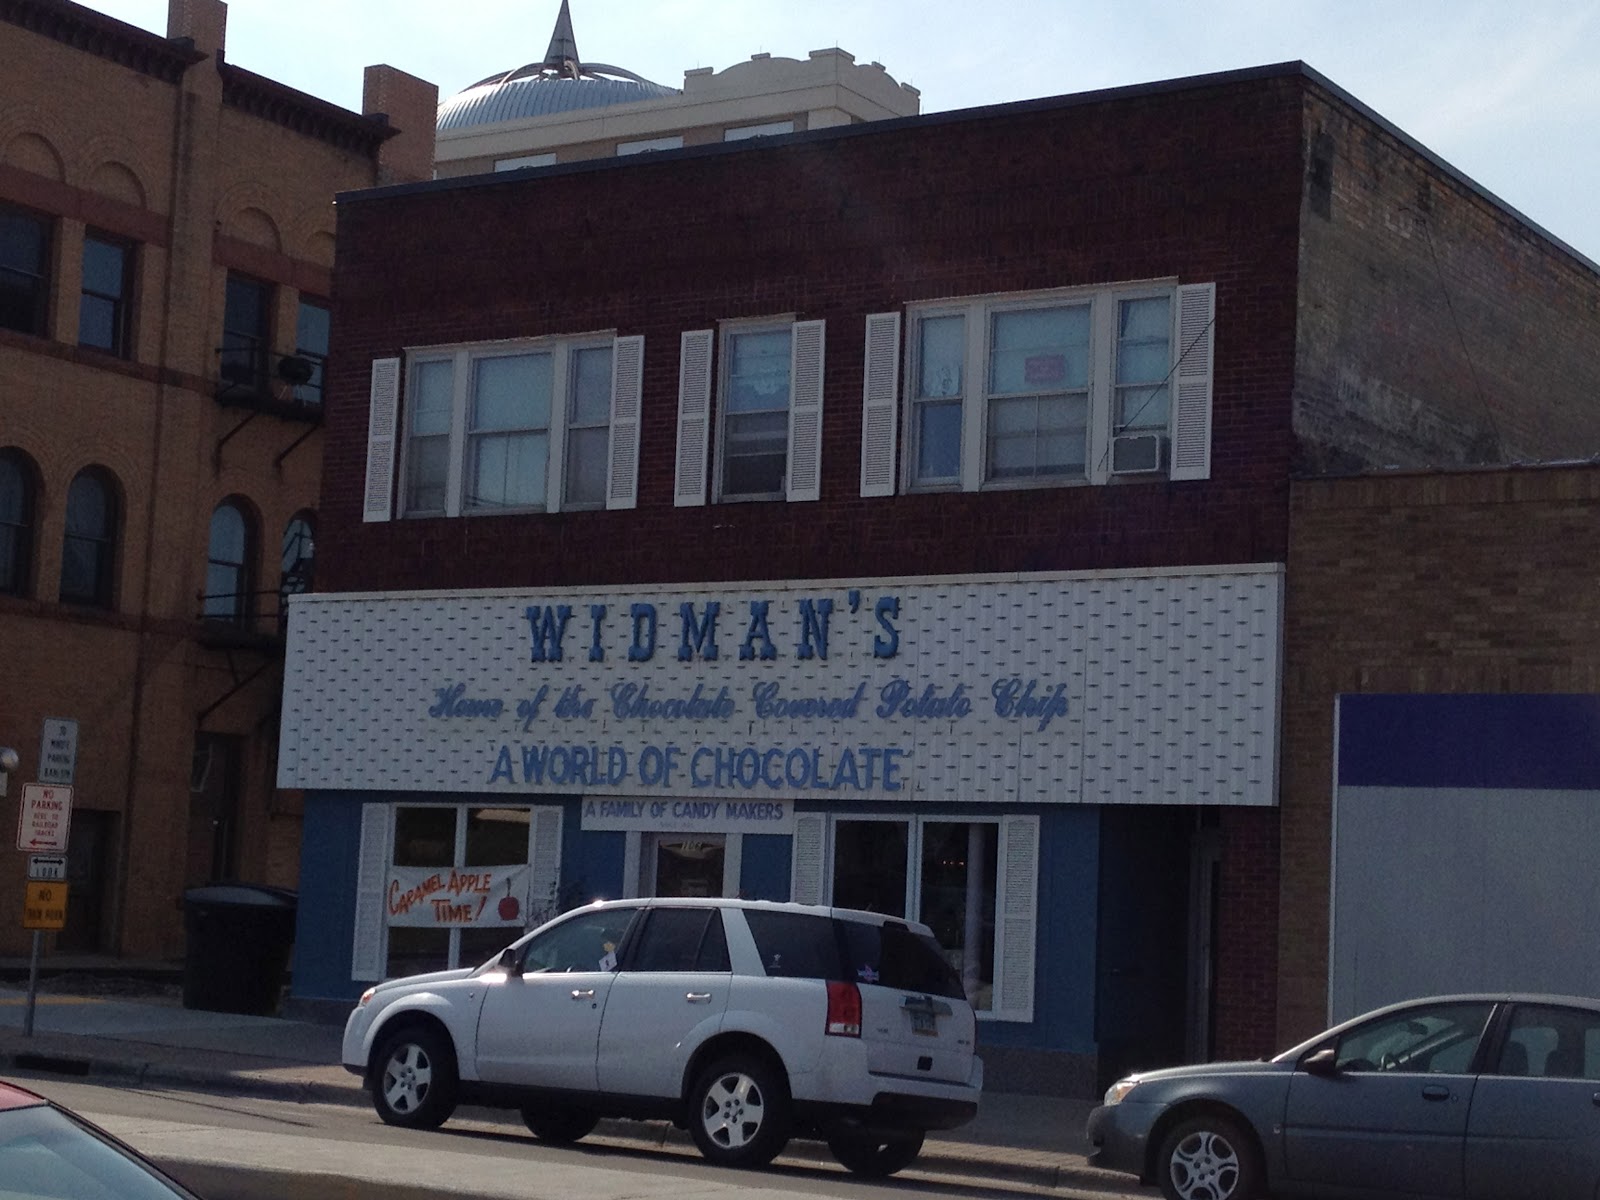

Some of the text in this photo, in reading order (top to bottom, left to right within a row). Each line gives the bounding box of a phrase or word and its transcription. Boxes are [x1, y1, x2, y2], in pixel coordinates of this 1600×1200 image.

[526, 590, 899, 662] WIDMAN'S
[517, 684, 548, 733] of
[611, 683, 735, 719] Chocolate
[752, 681, 866, 719] Covered
[876, 679, 971, 719] Potato
[490, 746, 903, 792] A WORLD OF CHOCOLATE
[31, 799, 62, 811] PARKING
[43, 790, 54, 800] NO
[584, 802, 784, 821] A FAMILY OF CANDY MAKERS
[387, 867, 492, 916] CARAMEL APPLE
[430, 895, 488, 923] TIME!
